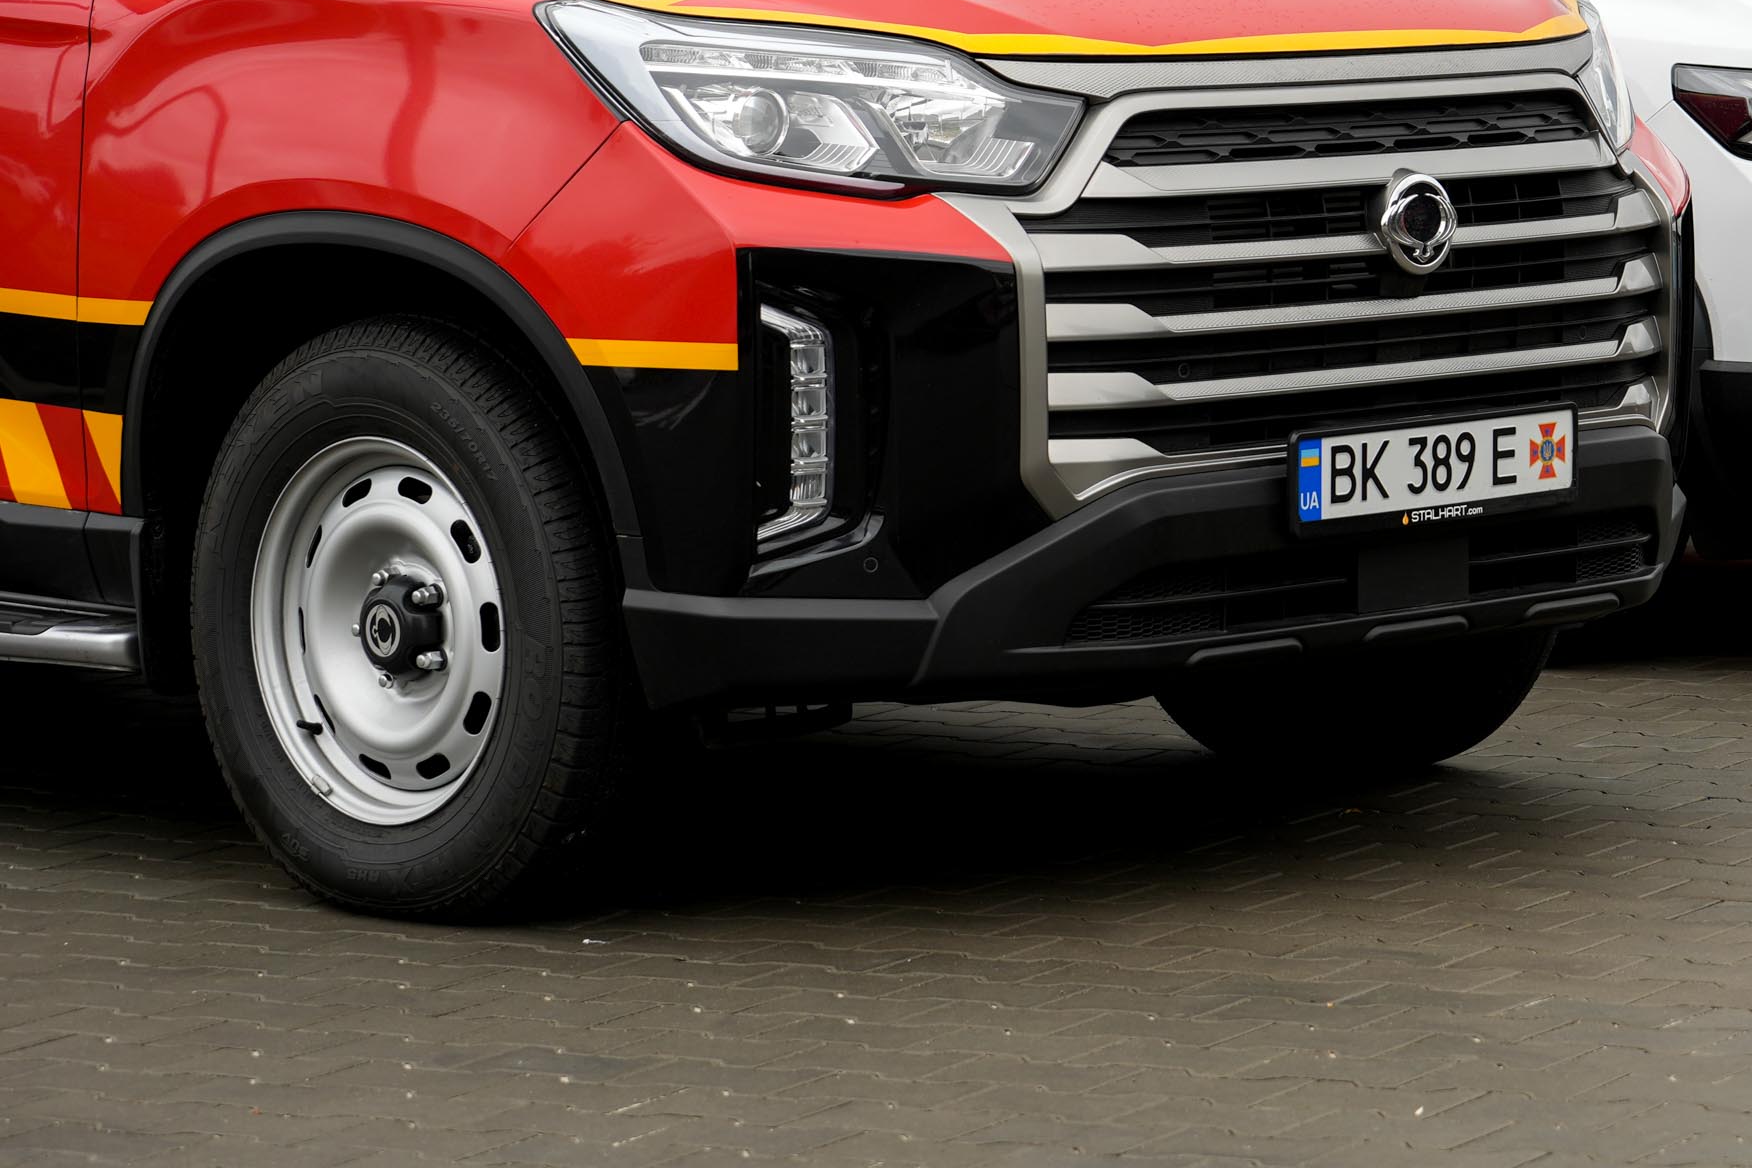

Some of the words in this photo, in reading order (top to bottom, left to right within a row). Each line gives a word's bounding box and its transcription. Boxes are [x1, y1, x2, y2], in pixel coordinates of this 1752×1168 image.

[1330, 439, 1390, 505] BK
[1407, 431, 1477, 496] 389
[1492, 426, 1517, 486] E
[1301, 491, 1319, 511] UA
[1411, 504, 1483, 522] STALHART.com
